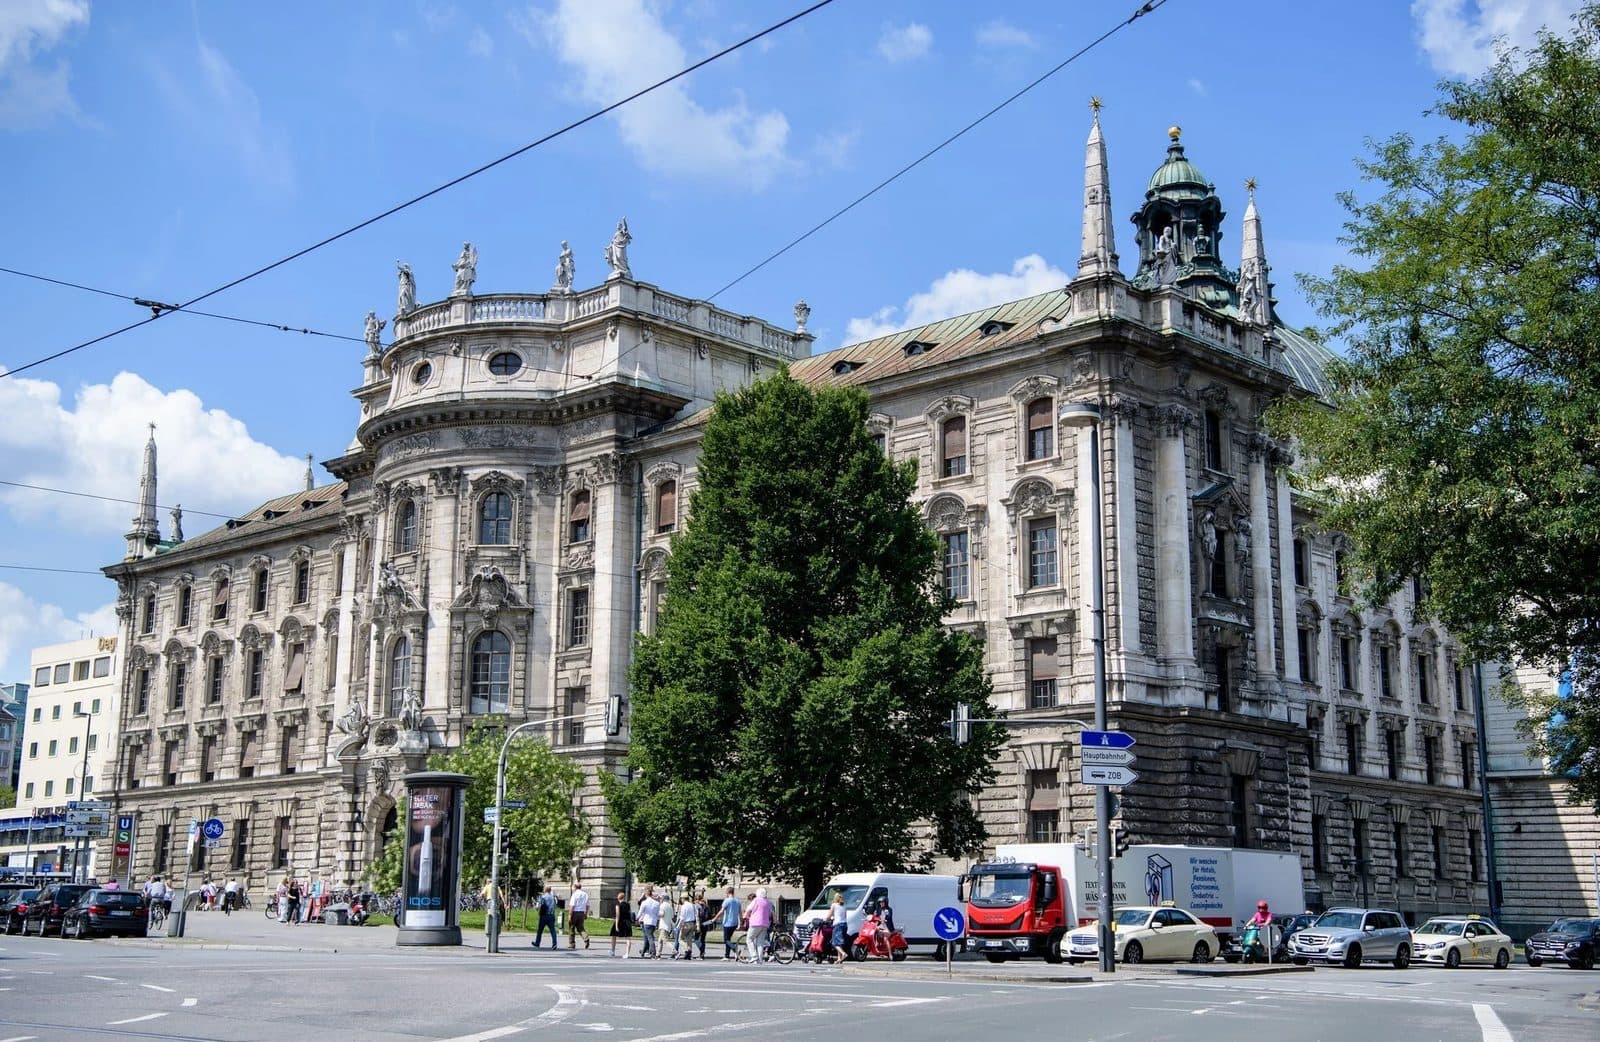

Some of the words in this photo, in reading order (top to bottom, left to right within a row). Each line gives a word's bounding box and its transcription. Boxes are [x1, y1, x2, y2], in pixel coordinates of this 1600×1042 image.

[1083, 751, 1127, 760] Hauptbahnhof
[1107, 771, 1122, 780] ZOB
[121, 818, 129, 830] U
[119, 831, 129, 843] S
[409, 896, 441, 906] IQOS
